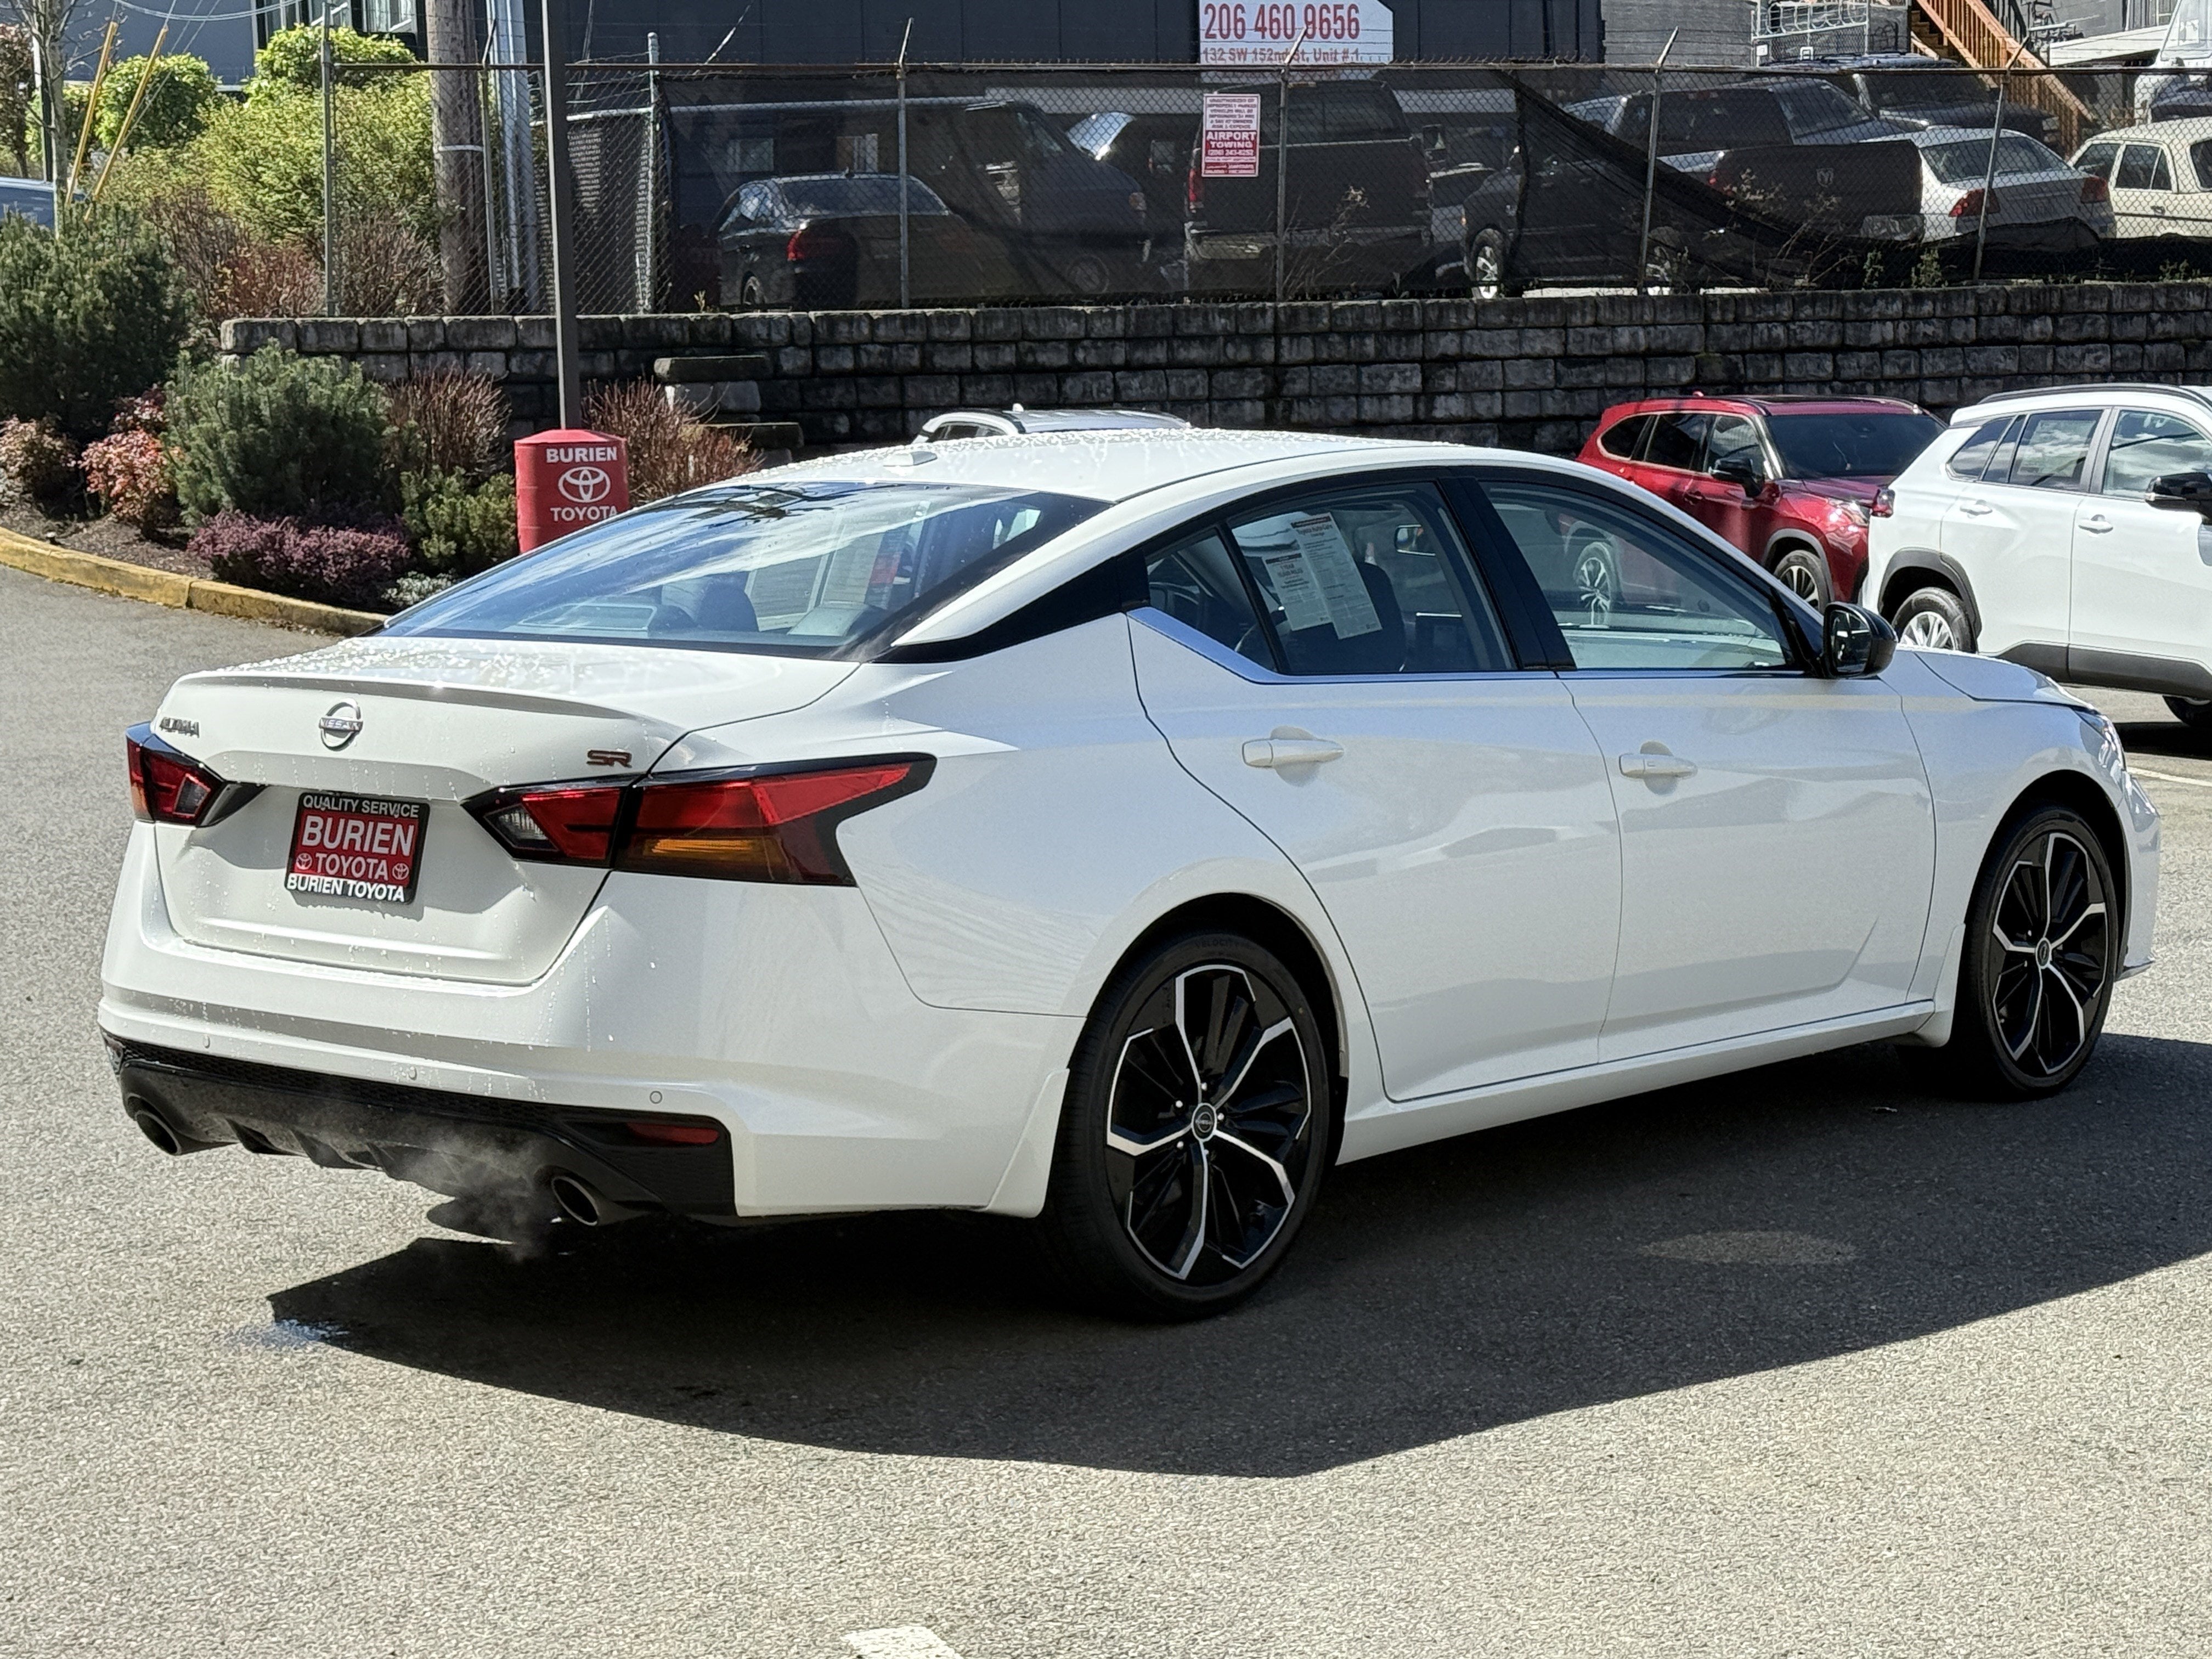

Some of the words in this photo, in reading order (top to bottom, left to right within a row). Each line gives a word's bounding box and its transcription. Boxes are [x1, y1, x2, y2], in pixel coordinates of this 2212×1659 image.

[1204, 3, 1246, 40] 206
[1255, 3, 1295, 40] 460
[1304, 3, 1360, 40] 9656
[1203, 47, 1226, 61] 132
[1228, 47, 1248, 61] SW
[1313, 48, 1338, 62] Unit
[1206, 131, 1257, 140] AIRPORT
[546, 447, 618, 463] BURIEN
[550, 505, 618, 522] TOYOTA
[320, 719, 360, 732] NISSAN
[586, 749, 633, 768] SR
[303, 795, 359, 812] QUALITY
[362, 800, 420, 818] SERVICE
[302, 815, 414, 856] BURIEN
[315, 853, 388, 881] TOYOTA
[287, 873, 343, 895] BURIEN
[347, 878, 405, 902] TOYOTA
